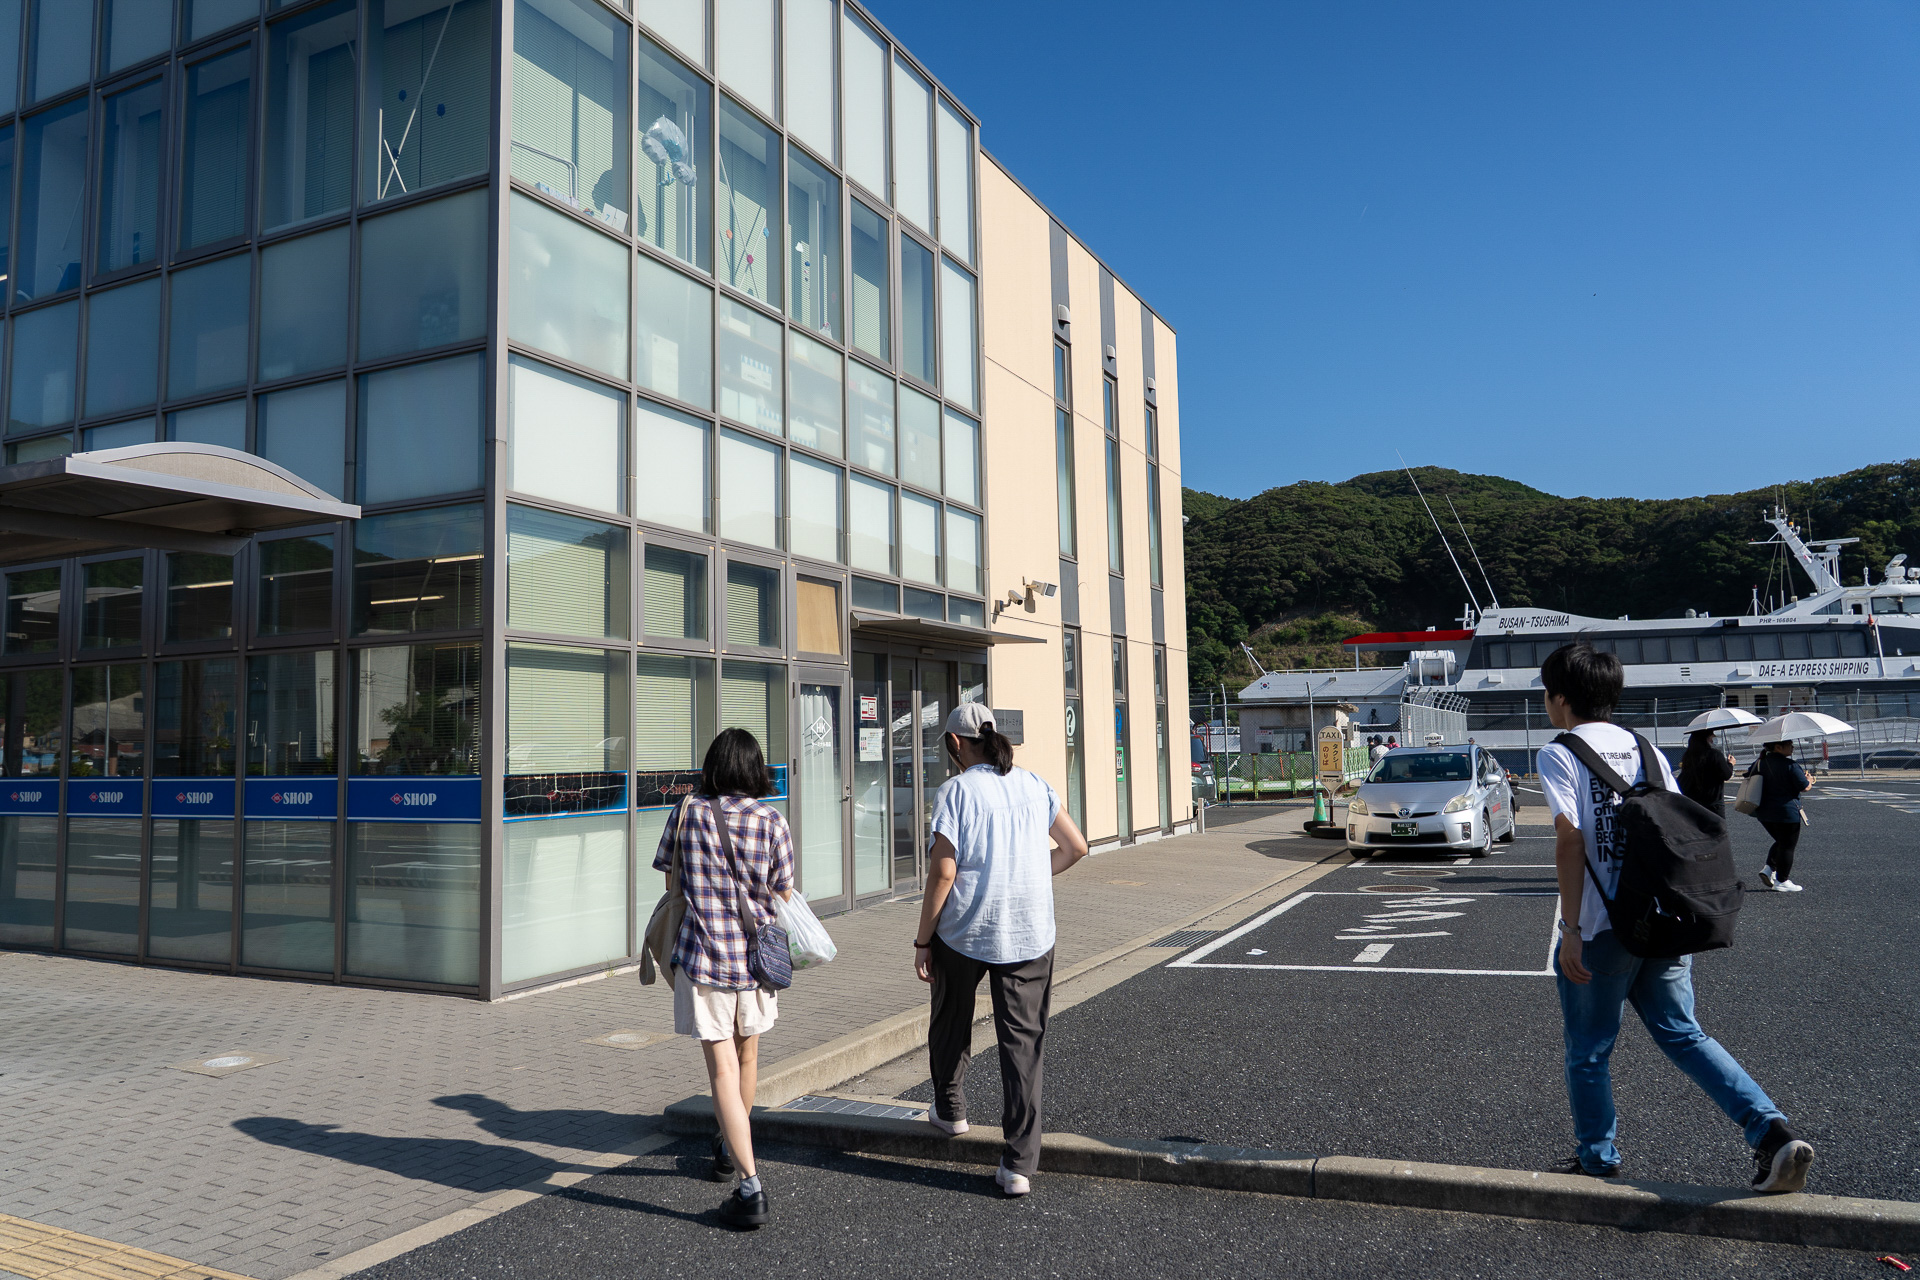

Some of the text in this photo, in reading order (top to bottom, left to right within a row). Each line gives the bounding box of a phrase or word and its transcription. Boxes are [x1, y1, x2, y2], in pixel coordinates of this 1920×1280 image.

[1498, 614, 1570, 629] BUSAN-TSUSHIMA
[1758, 661, 1870, 677] DAE-A EXPRESS SHIPPING
[816, 722, 826, 733] HK
[1319, 731, 1340, 739] TAXI
[1322, 746, 1330, 766] のりば
[1606, 751, 1632, 760] DREAMS
[19, 791, 42, 802] SHOP
[98, 791, 124, 803] SHOP
[186, 792, 214, 804] SHOP
[282, 792, 313, 805] SHOP
[403, 792, 437, 806] SHOP
